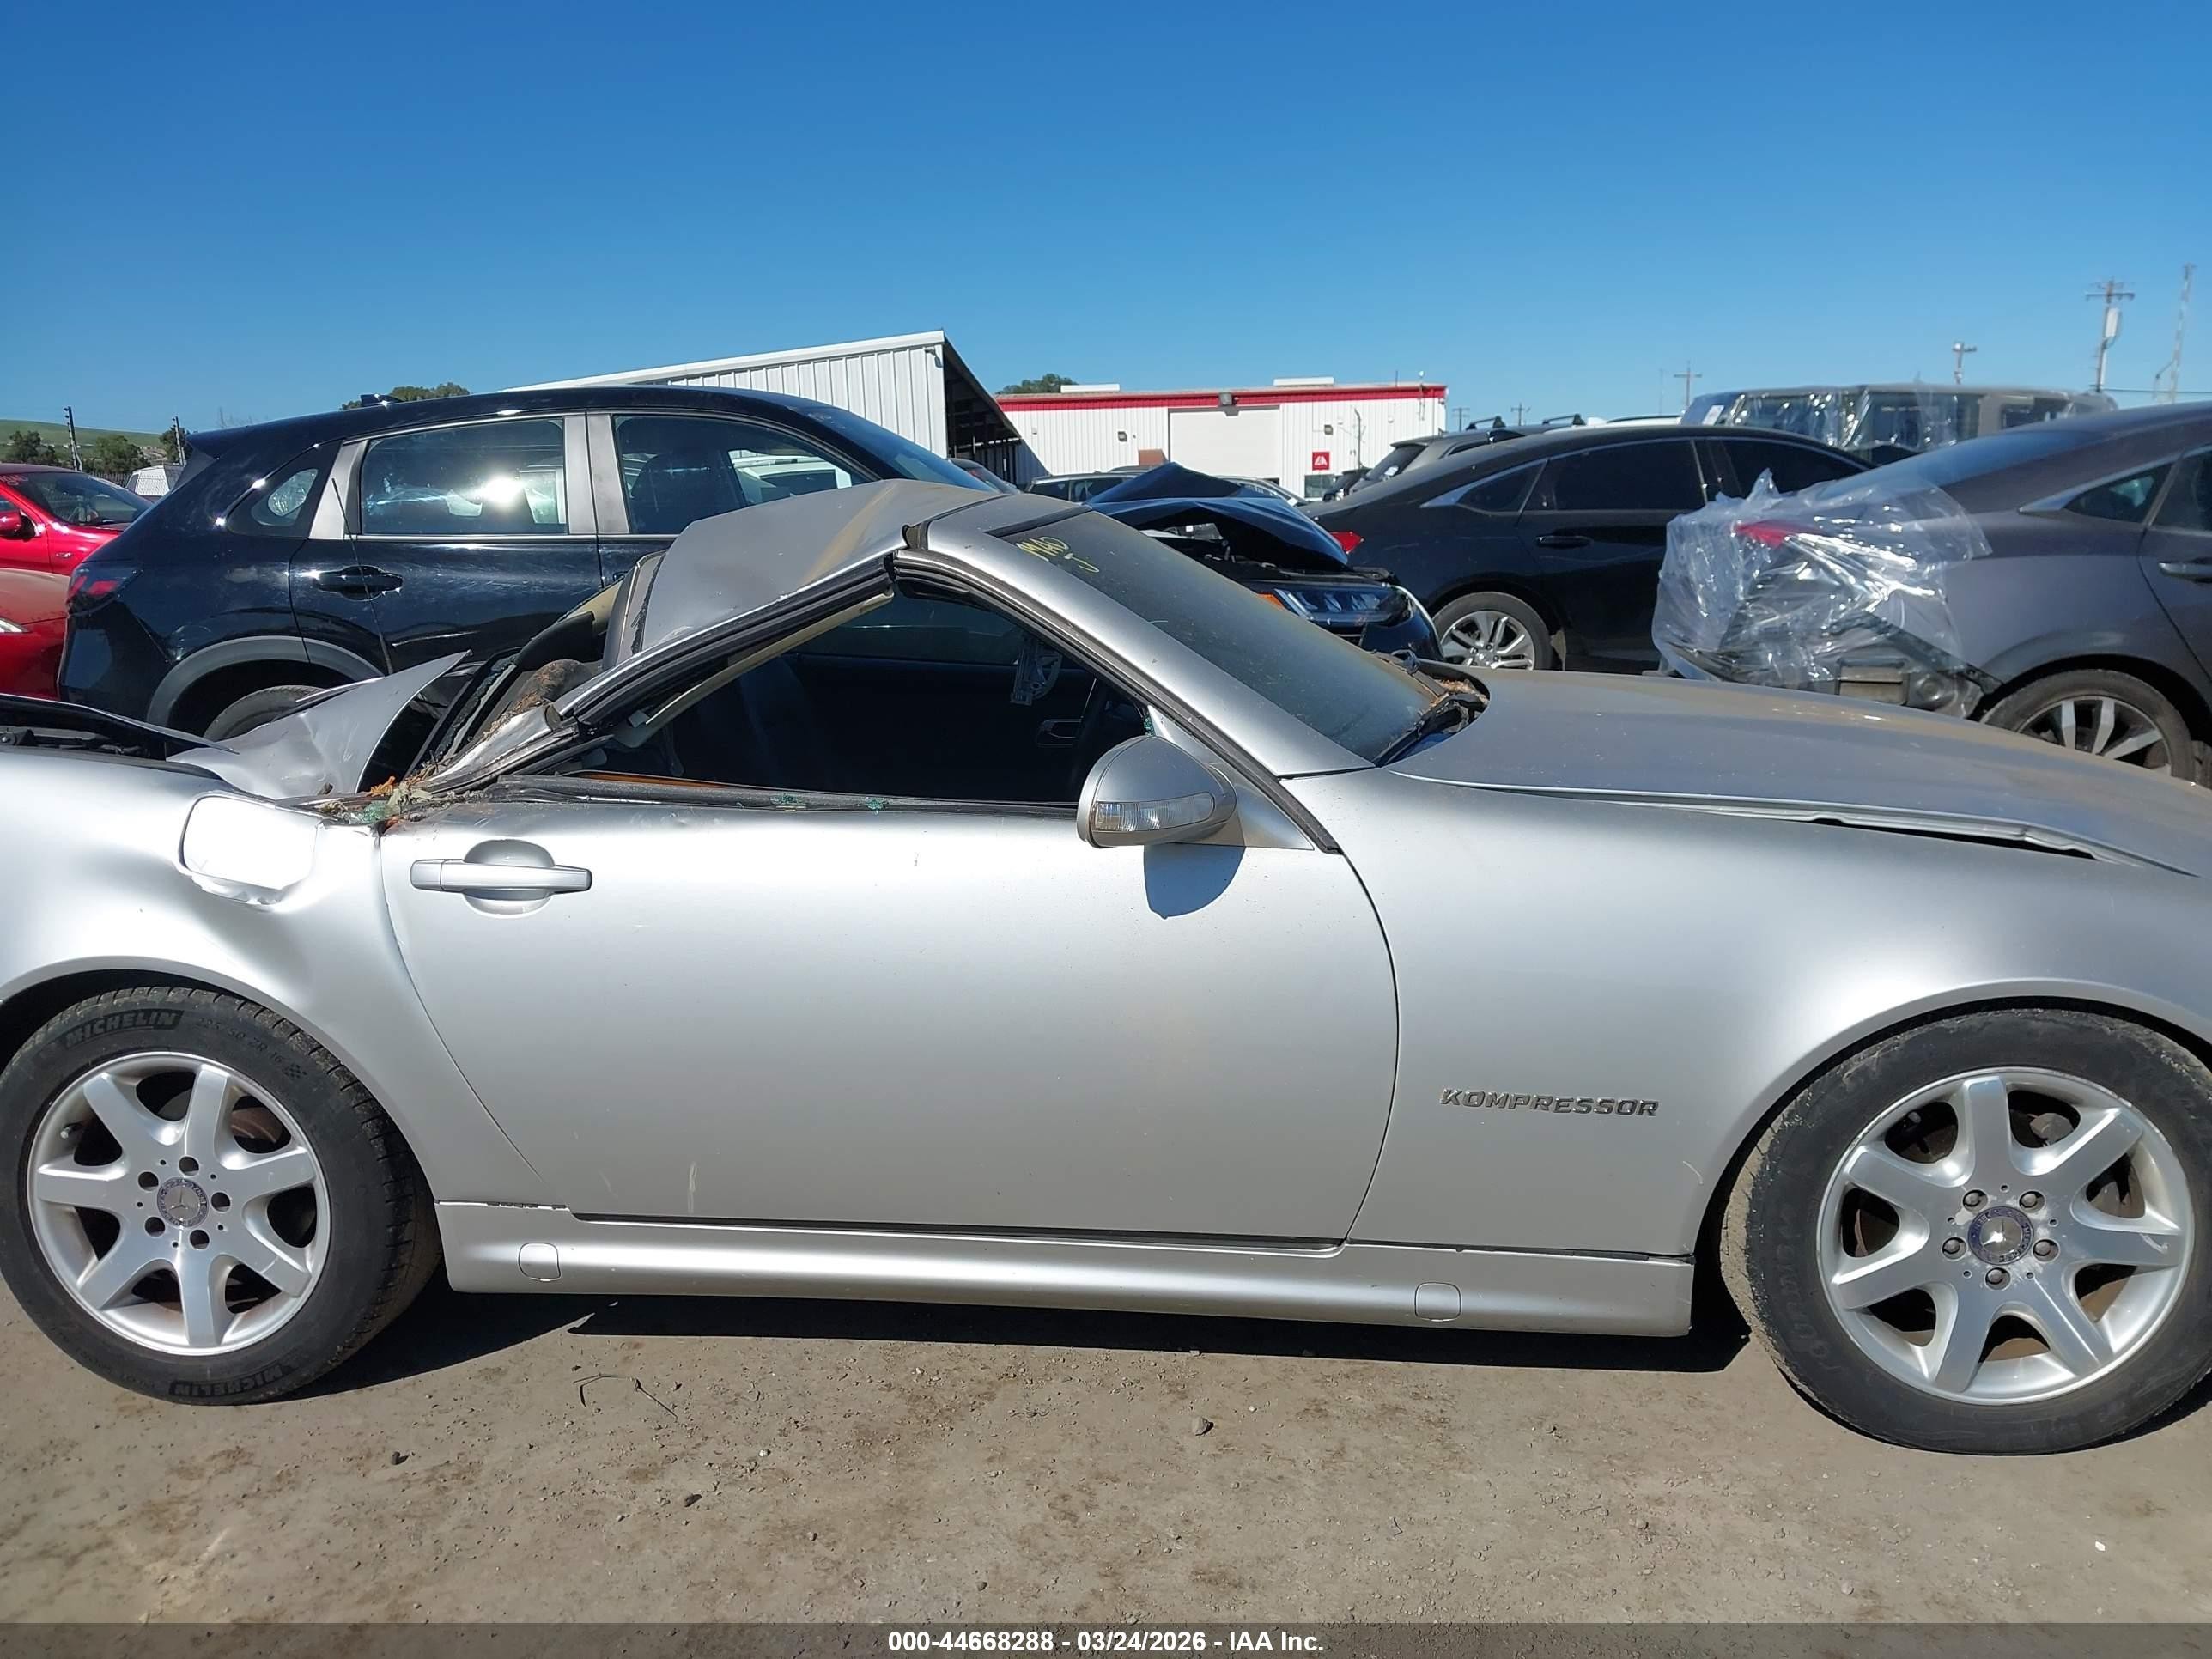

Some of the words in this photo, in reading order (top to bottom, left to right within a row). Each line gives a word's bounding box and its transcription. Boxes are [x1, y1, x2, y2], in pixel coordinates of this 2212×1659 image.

[65, 1011, 178, 1048] MICHELIN
[1439, 1088, 1660, 1117] KOMPRESSOR
[173, 1363, 283, 1396] MICHELIN
